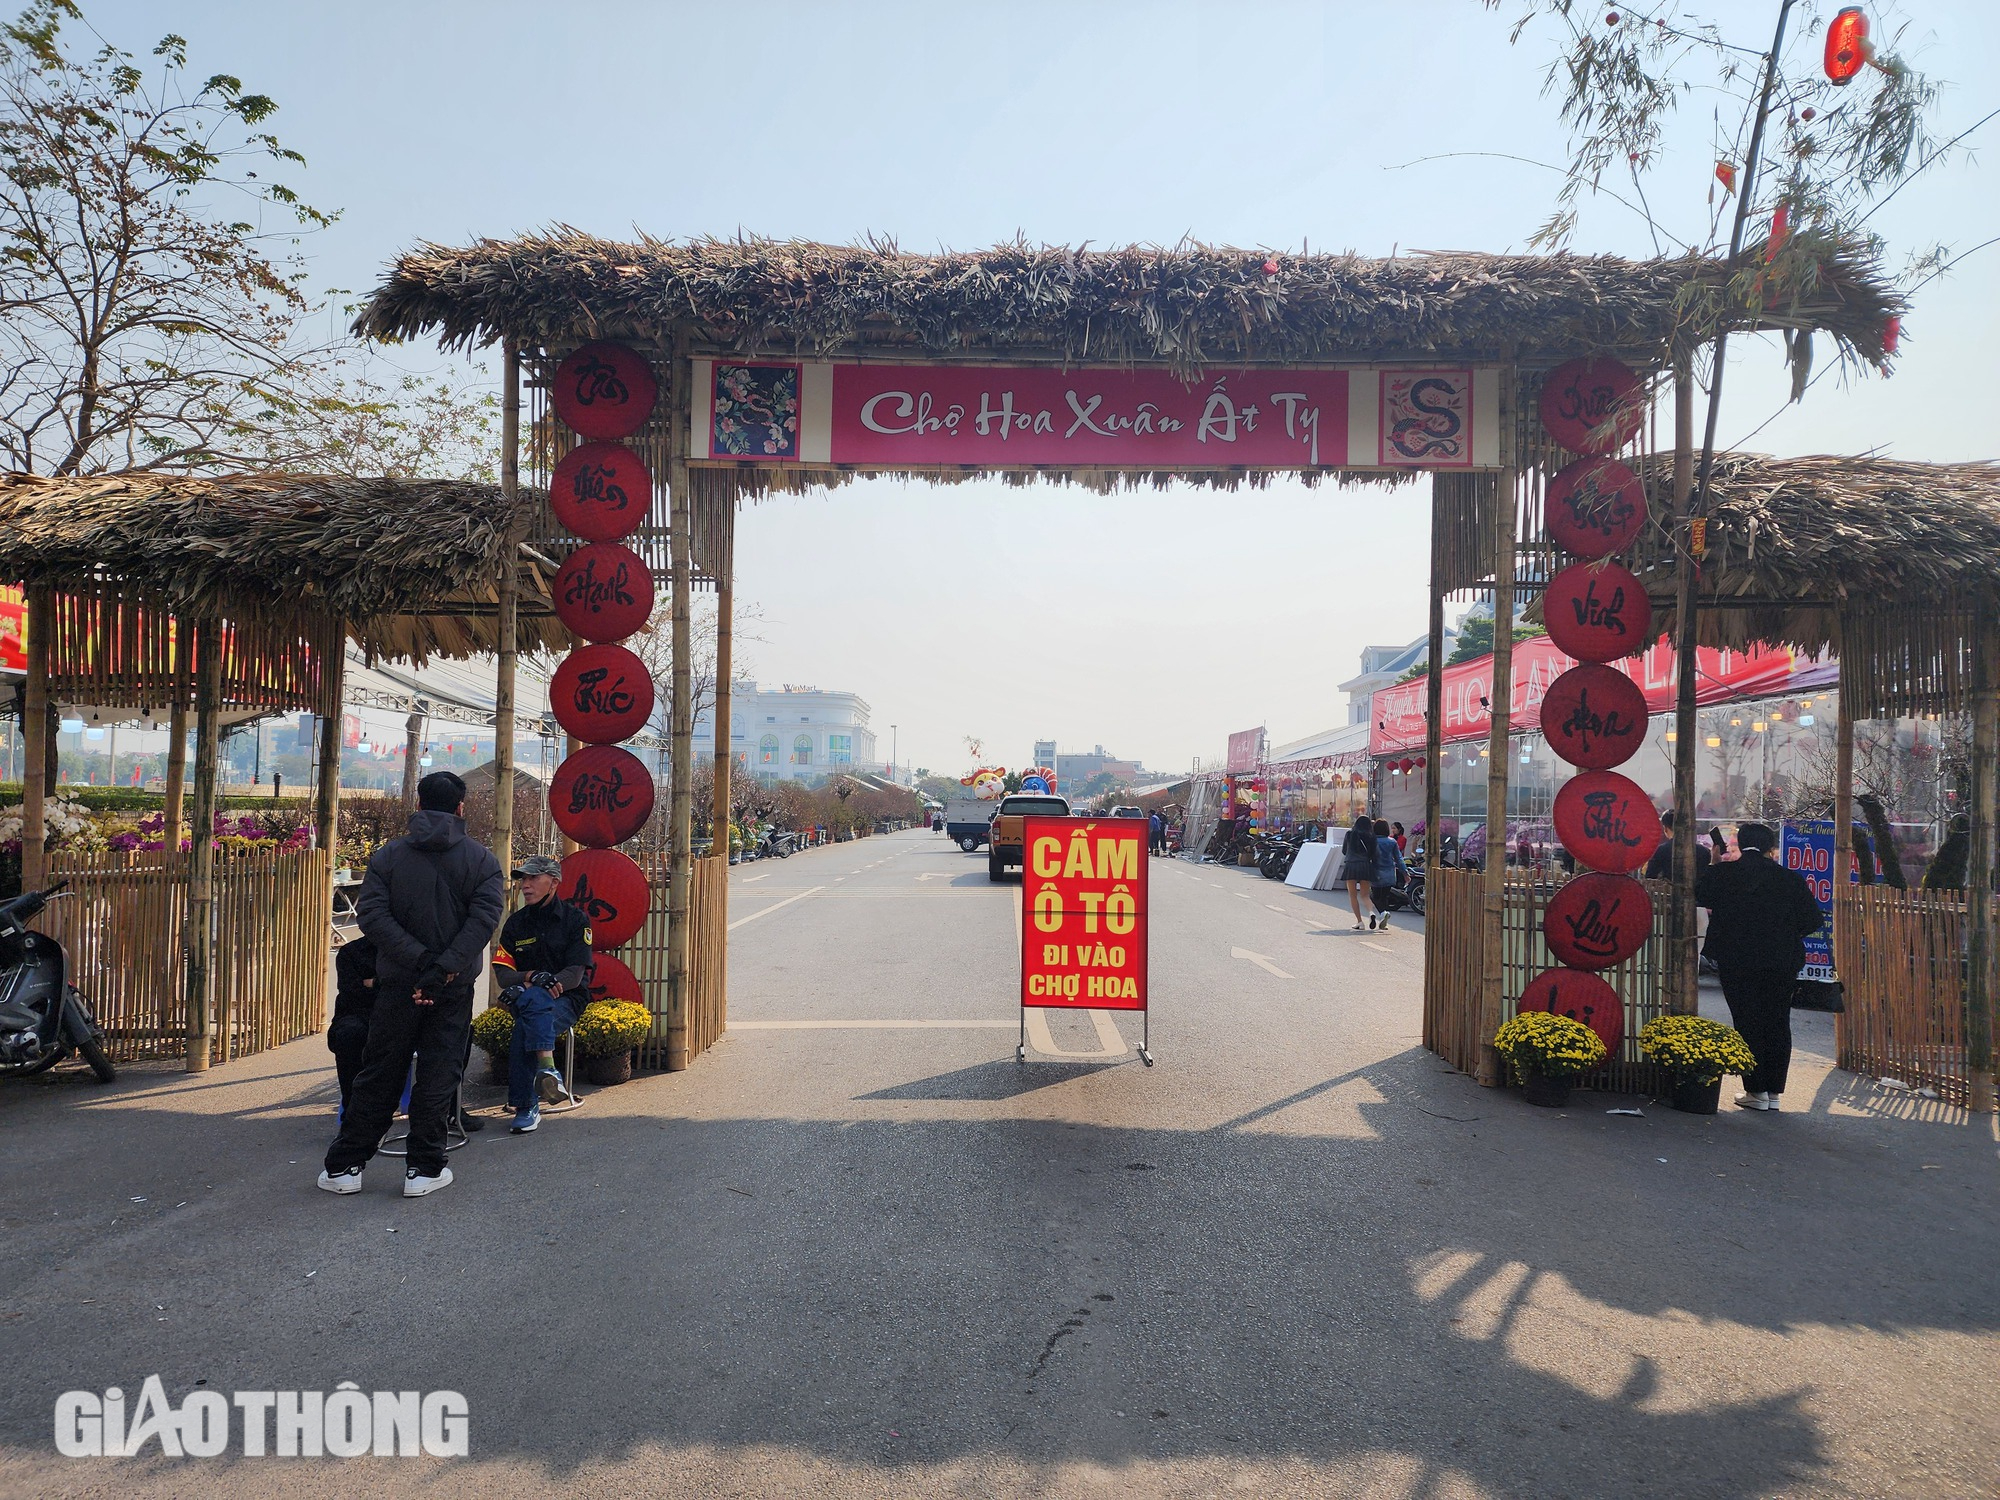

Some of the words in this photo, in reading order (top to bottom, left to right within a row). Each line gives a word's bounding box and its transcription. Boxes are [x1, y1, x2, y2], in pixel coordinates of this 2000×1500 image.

[860, 391, 965, 436] Chợ
[975, 391, 1055, 441] Hoa
[1064, 390, 1186, 439] Xuân
[1197, 376, 1260, 444] Ất
[1270, 392, 1320, 465] Tỵ
[783, 683, 816, 693] WinMart
[1033, 824, 1138, 879] CẤM
[1788, 843, 1829, 872] ĐÀO
[1034, 882, 1063, 933] Ô
[1079, 884, 1136, 935] TÔ
[1043, 944, 1068, 966] ĐI
[1077, 942, 1126, 967] VÀO
[1028, 973, 1080, 1001] CHỢ
[1088, 976, 1138, 998] HOA
